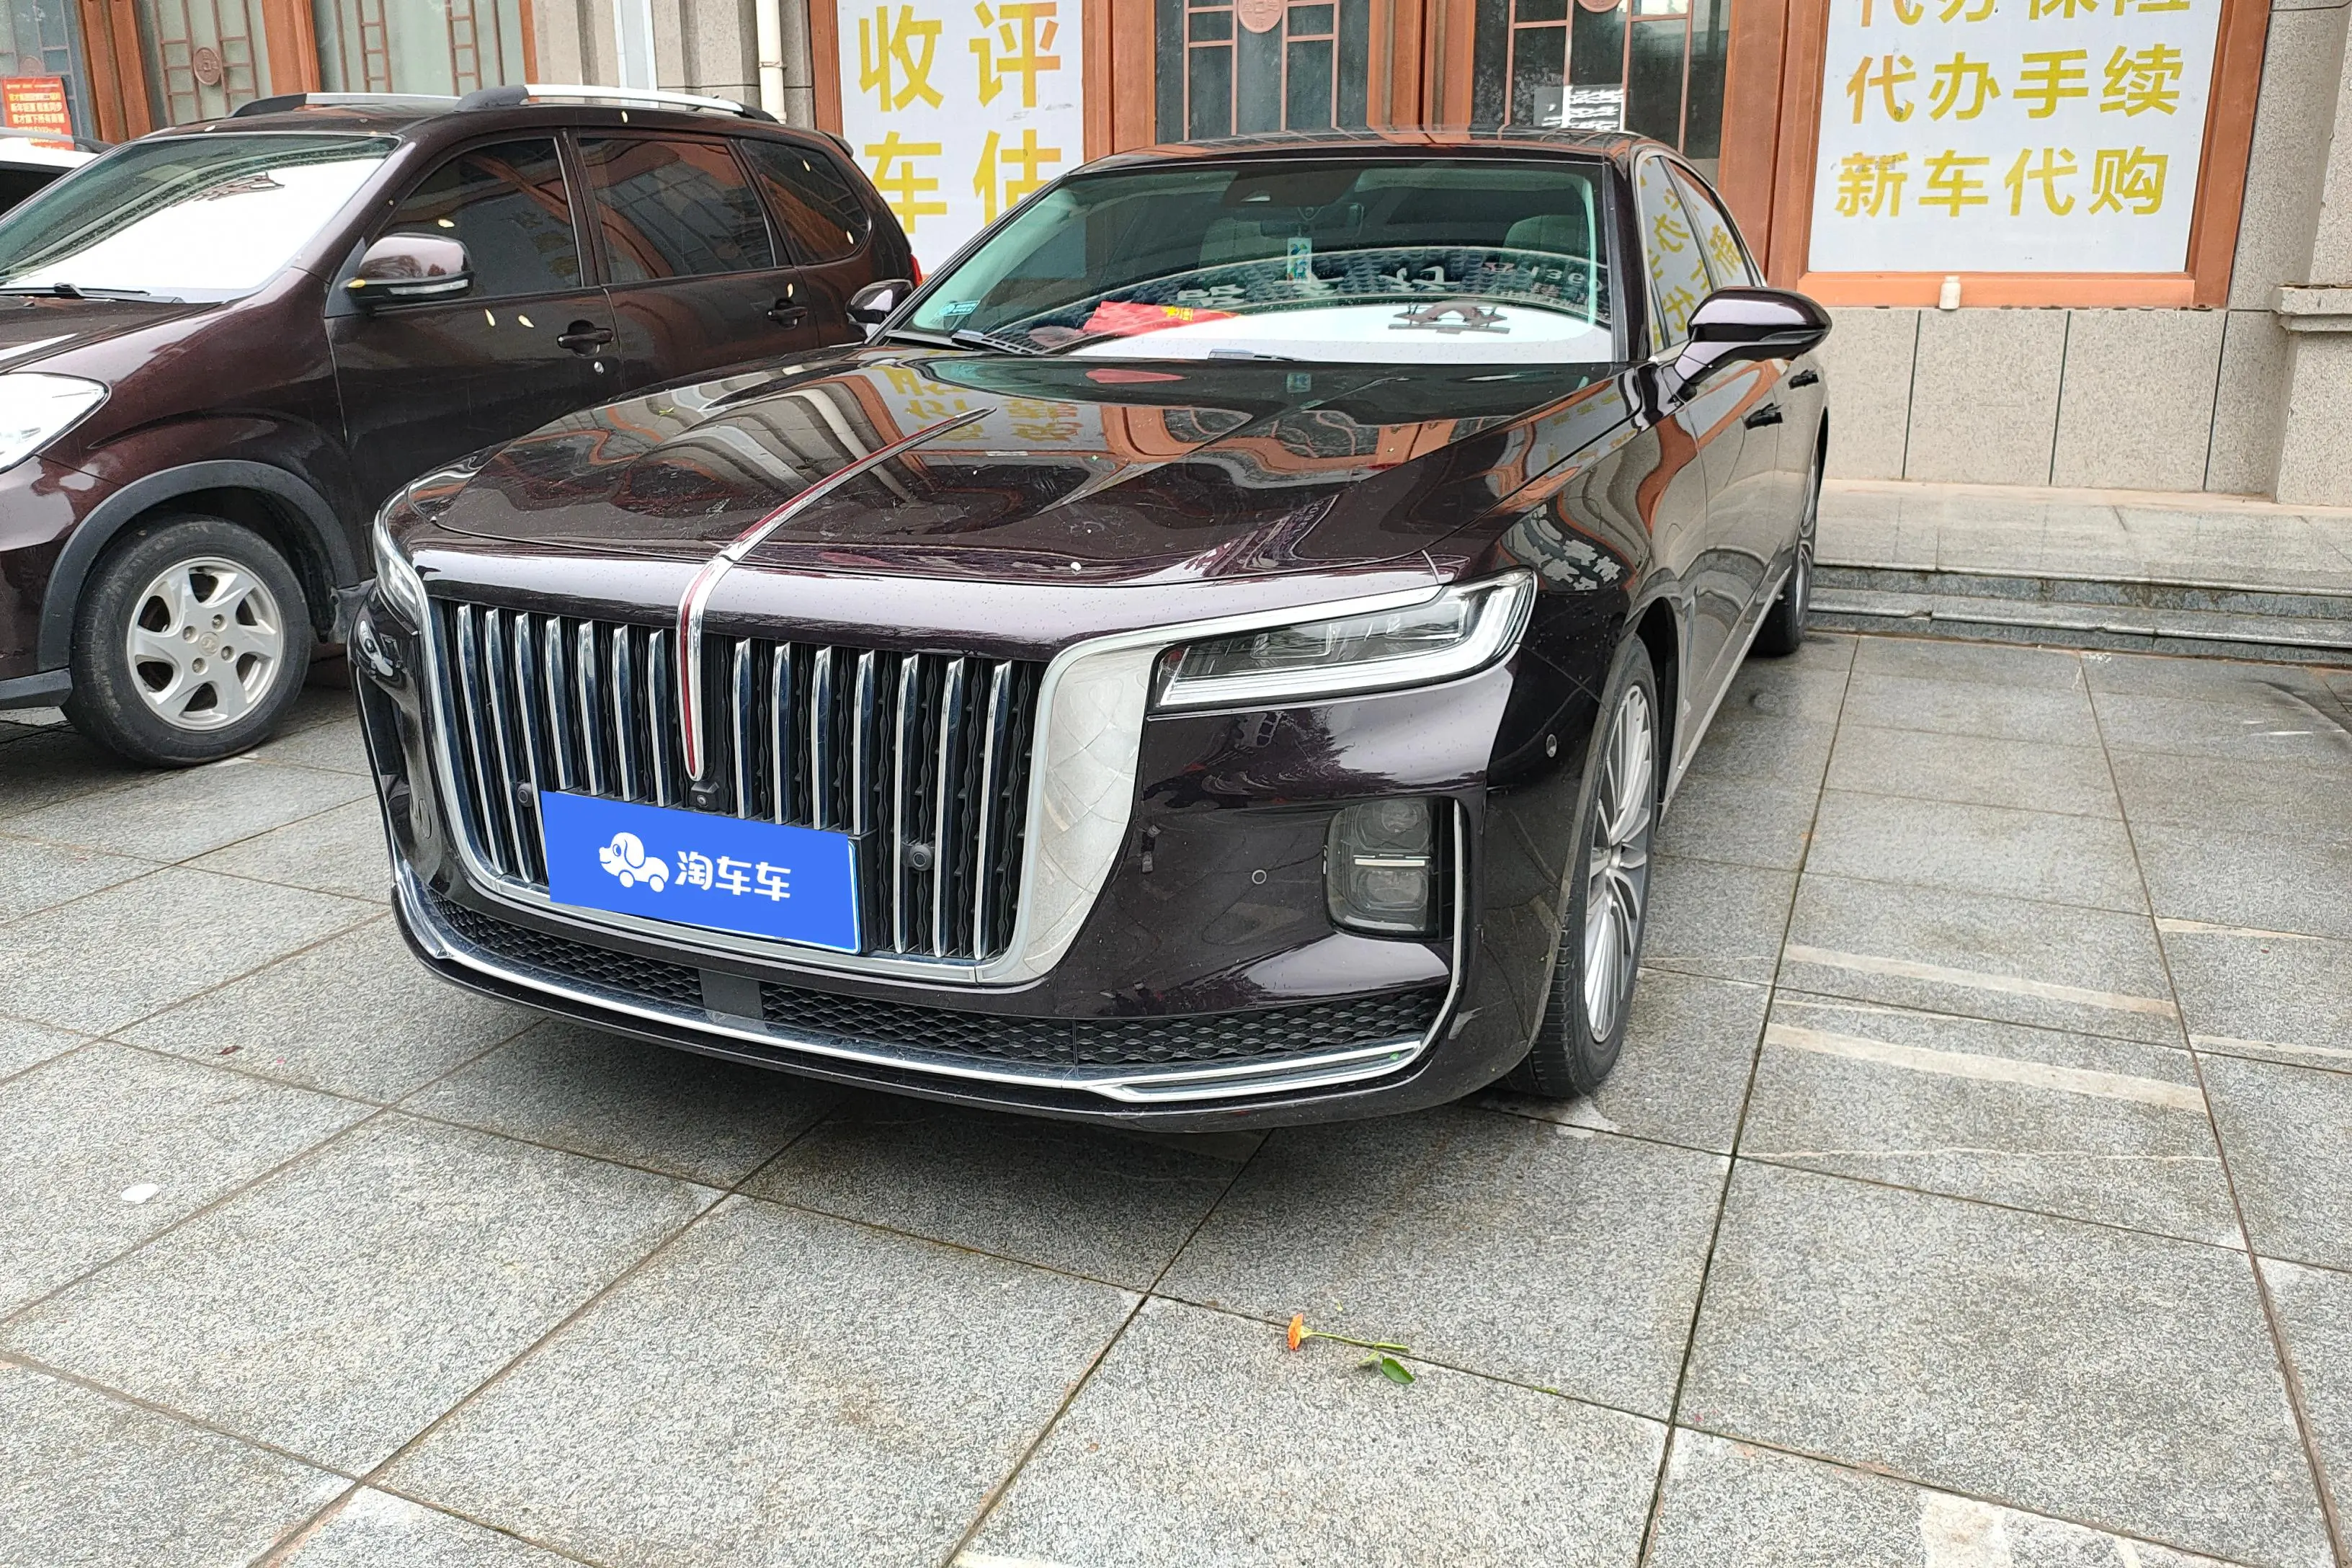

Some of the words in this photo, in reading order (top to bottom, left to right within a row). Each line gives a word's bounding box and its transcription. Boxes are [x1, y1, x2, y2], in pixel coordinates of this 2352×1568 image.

[1846, 43, 2184, 124] 代办手续
[1834, 146, 2169, 218] 新车代购
